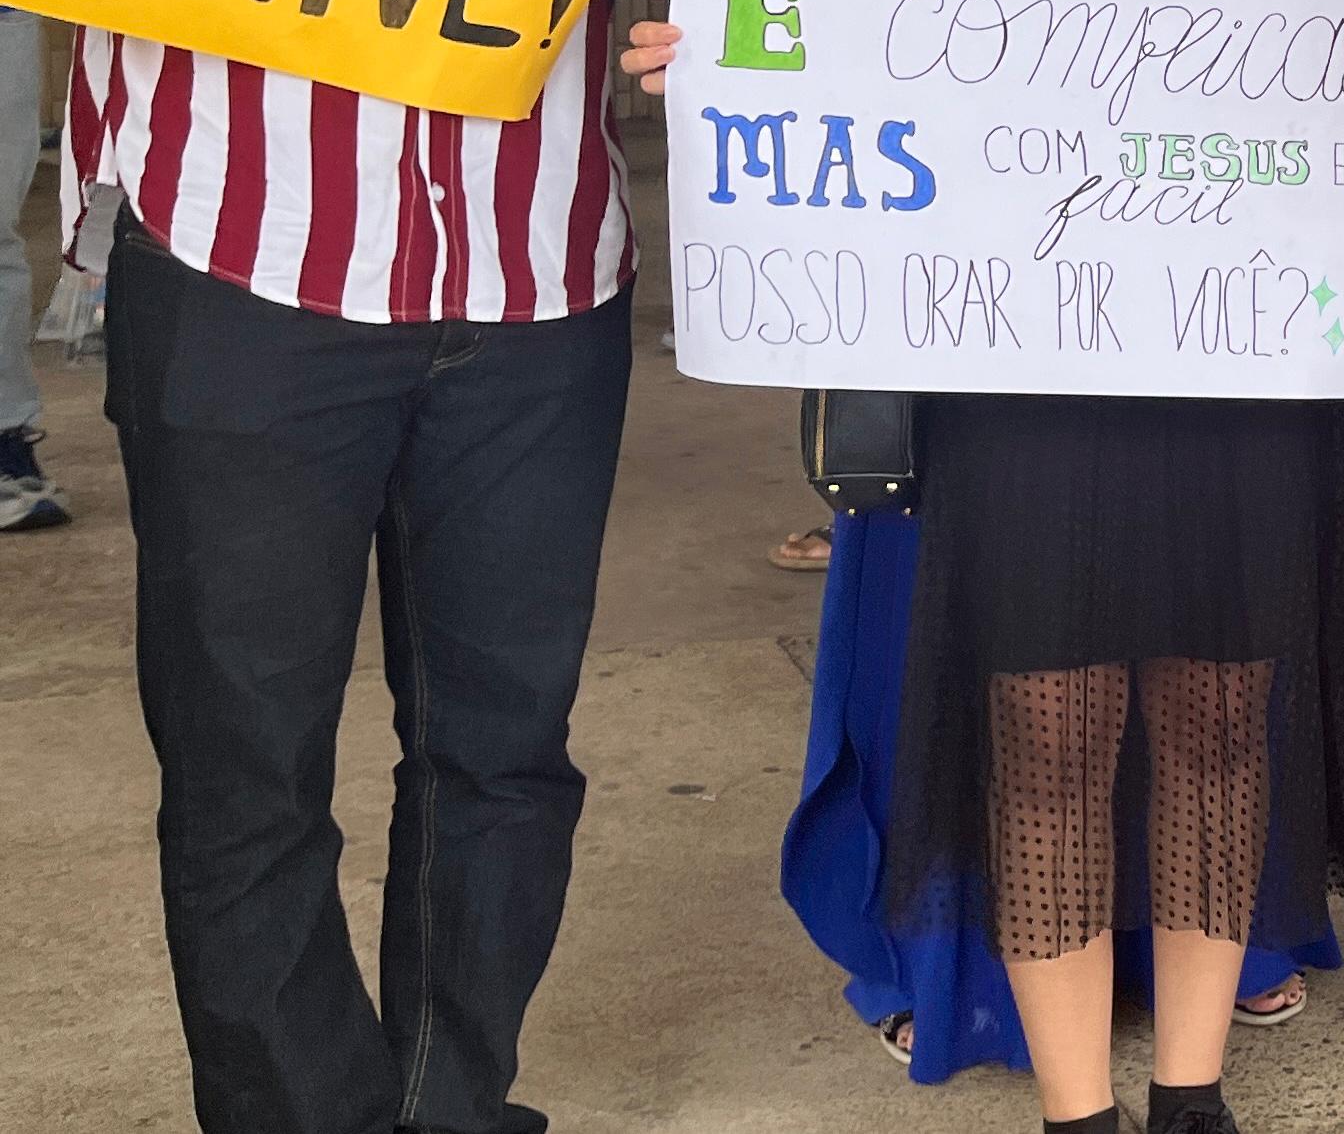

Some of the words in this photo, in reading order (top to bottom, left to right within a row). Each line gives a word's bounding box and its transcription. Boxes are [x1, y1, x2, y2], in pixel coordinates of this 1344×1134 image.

[701, 106, 938, 213] MAS
[984, 125, 1089, 177] COM
[1119, 131, 1311, 188] JESUS
[682, 242, 868, 349] POSSO
[903, 258, 1022, 351] ORAR
[1057, 261, 1123, 354] POR
[1168, 249, 1311, 358] VOCÊ?
